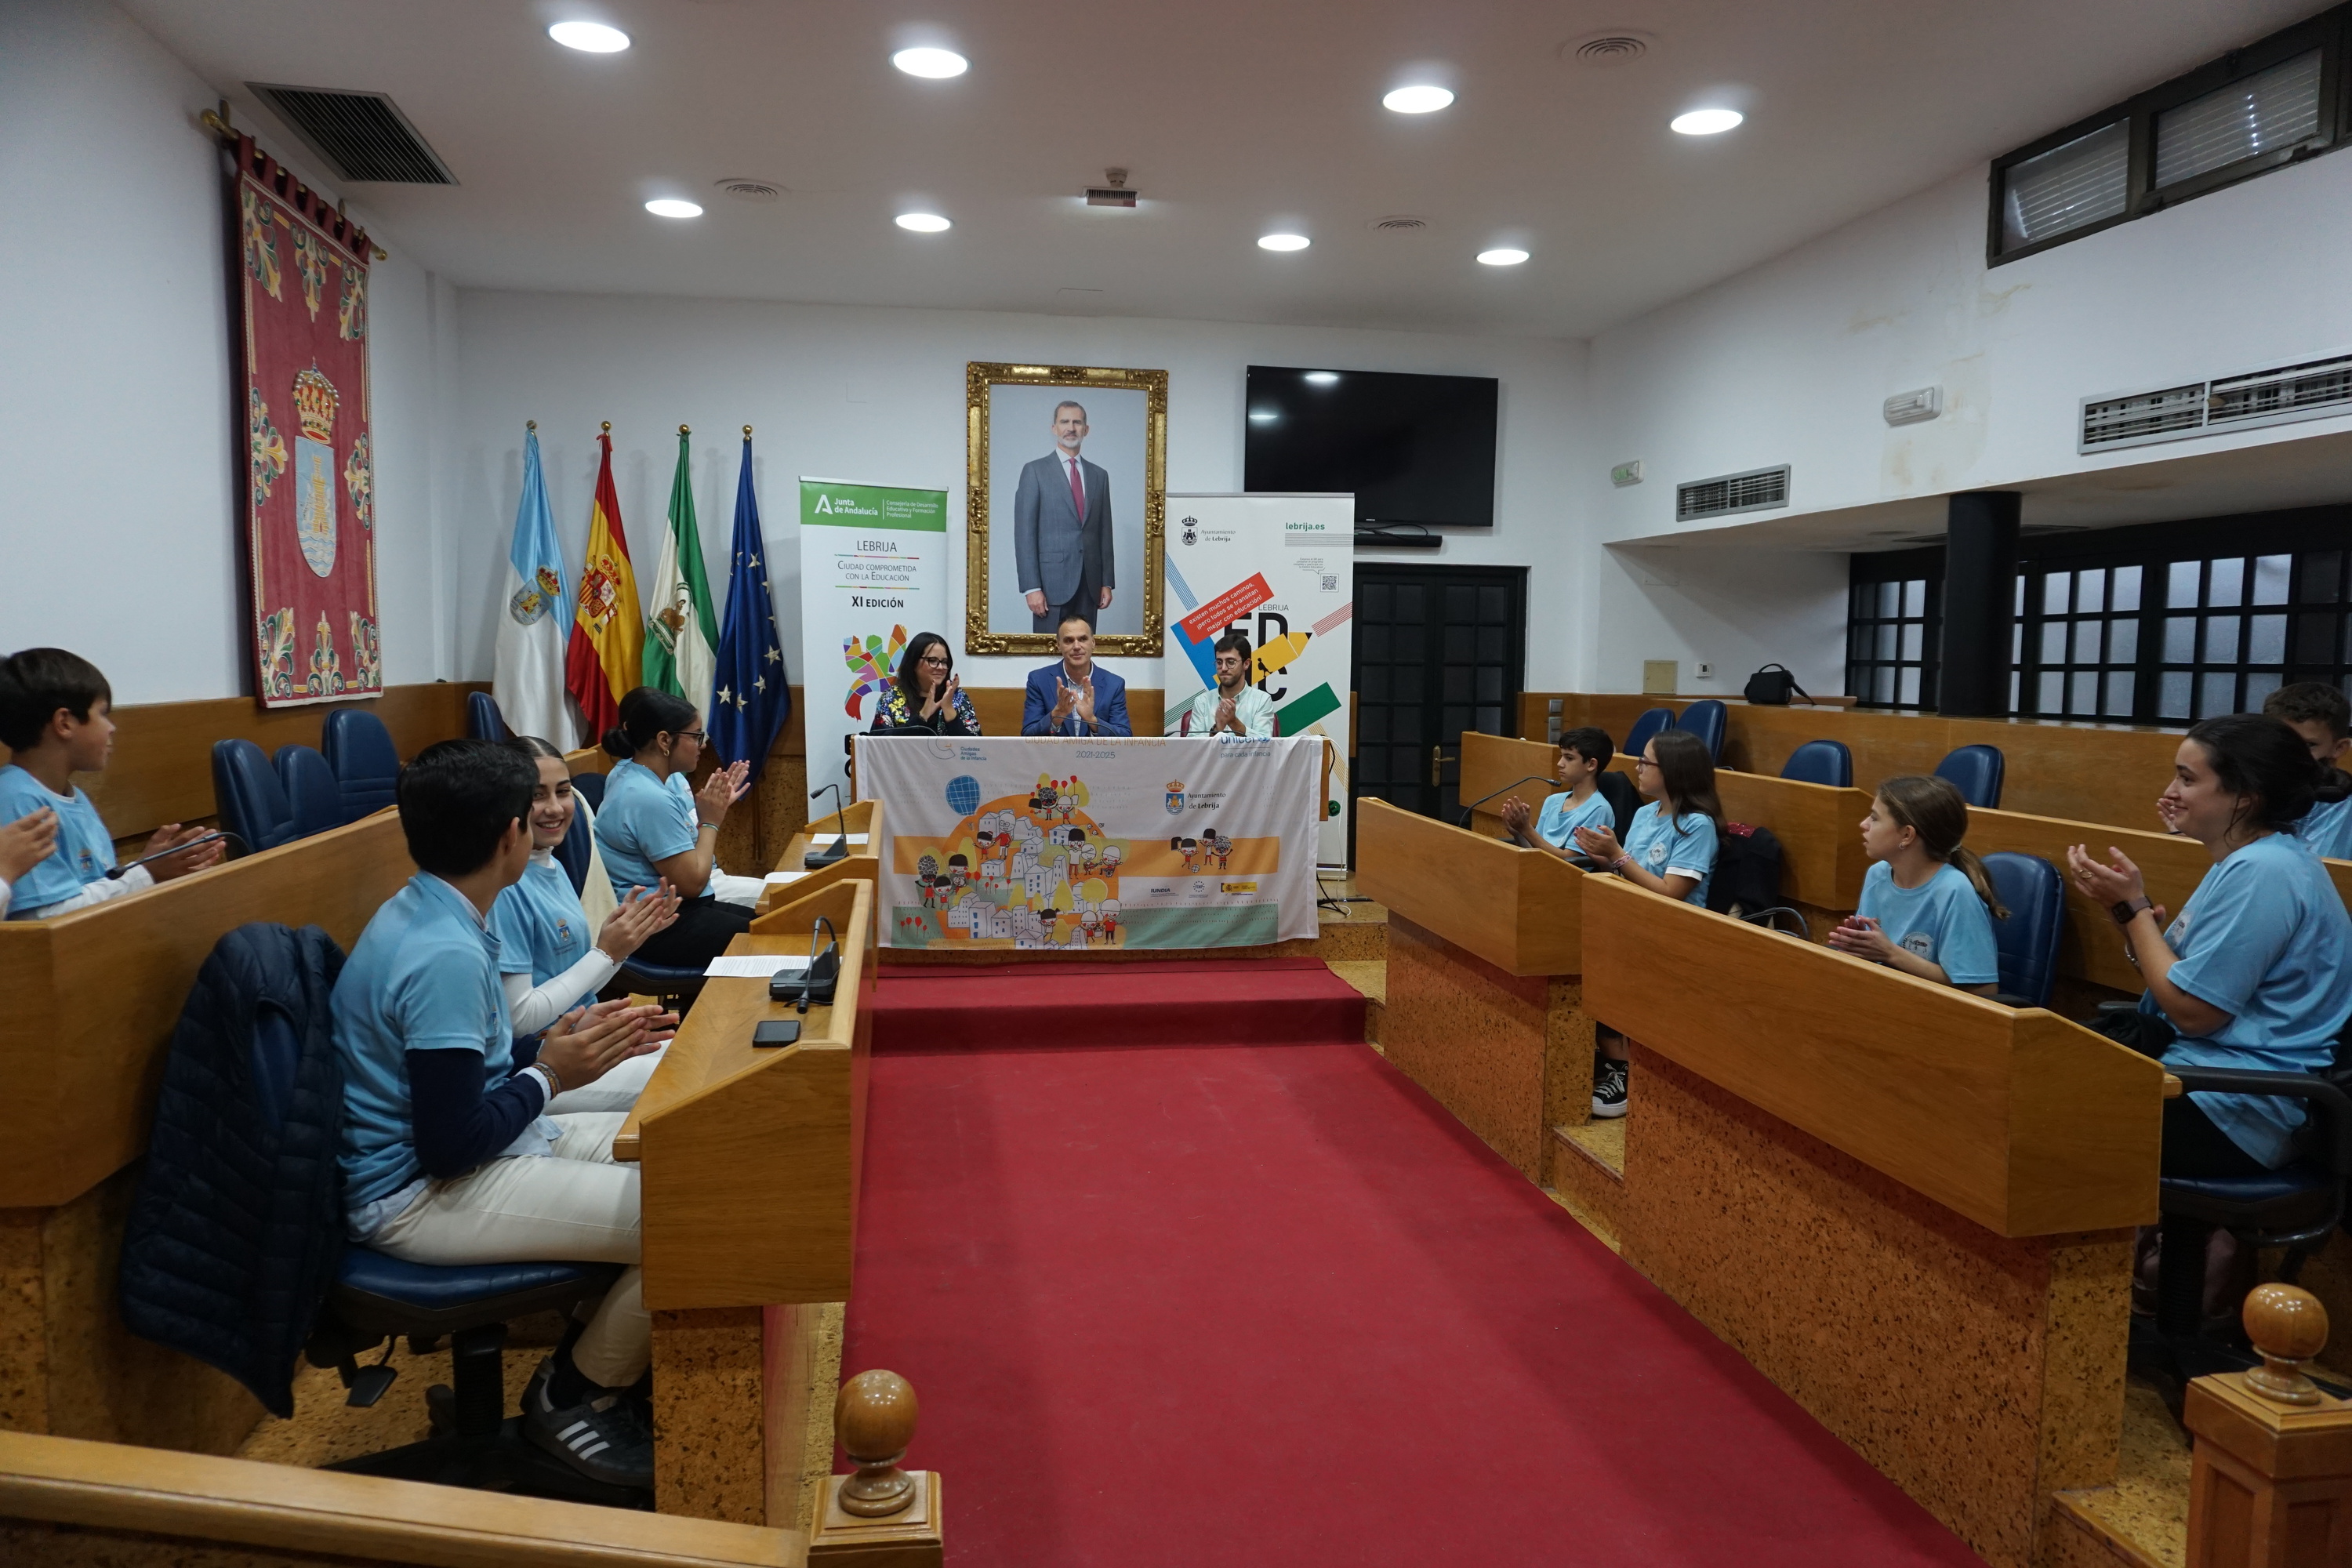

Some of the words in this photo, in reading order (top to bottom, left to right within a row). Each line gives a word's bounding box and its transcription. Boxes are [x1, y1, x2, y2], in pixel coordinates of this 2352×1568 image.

[834, 498, 855, 506] Junta
[844, 506, 878, 516] Andalucía
[1286, 522, 1326, 532] lebrija.es
[857, 540, 898, 552] LEBRIJA
[851, 596, 863, 607] XI
[866, 597, 904, 608] EDICIÓN
[1210, 608, 1227, 620] todos
[1234, 589, 1258, 606] transitan
[1189, 610, 1209, 624] existen
[1208, 597, 1230, 612] muchos
[1207, 620, 1223, 633] mejor
[1223, 613, 1234, 622] con
[1234, 594, 1263, 615] educación!
[1025, 736, 1059, 745] CIUDAD
[1062, 736, 1094, 746] AMIGA
[1097, 737, 1108, 746] DE
[1110, 737, 1122, 746] LA
[1124, 737, 1167, 747] INFANCIA
[1076, 750, 1116, 759] 2021-2025
